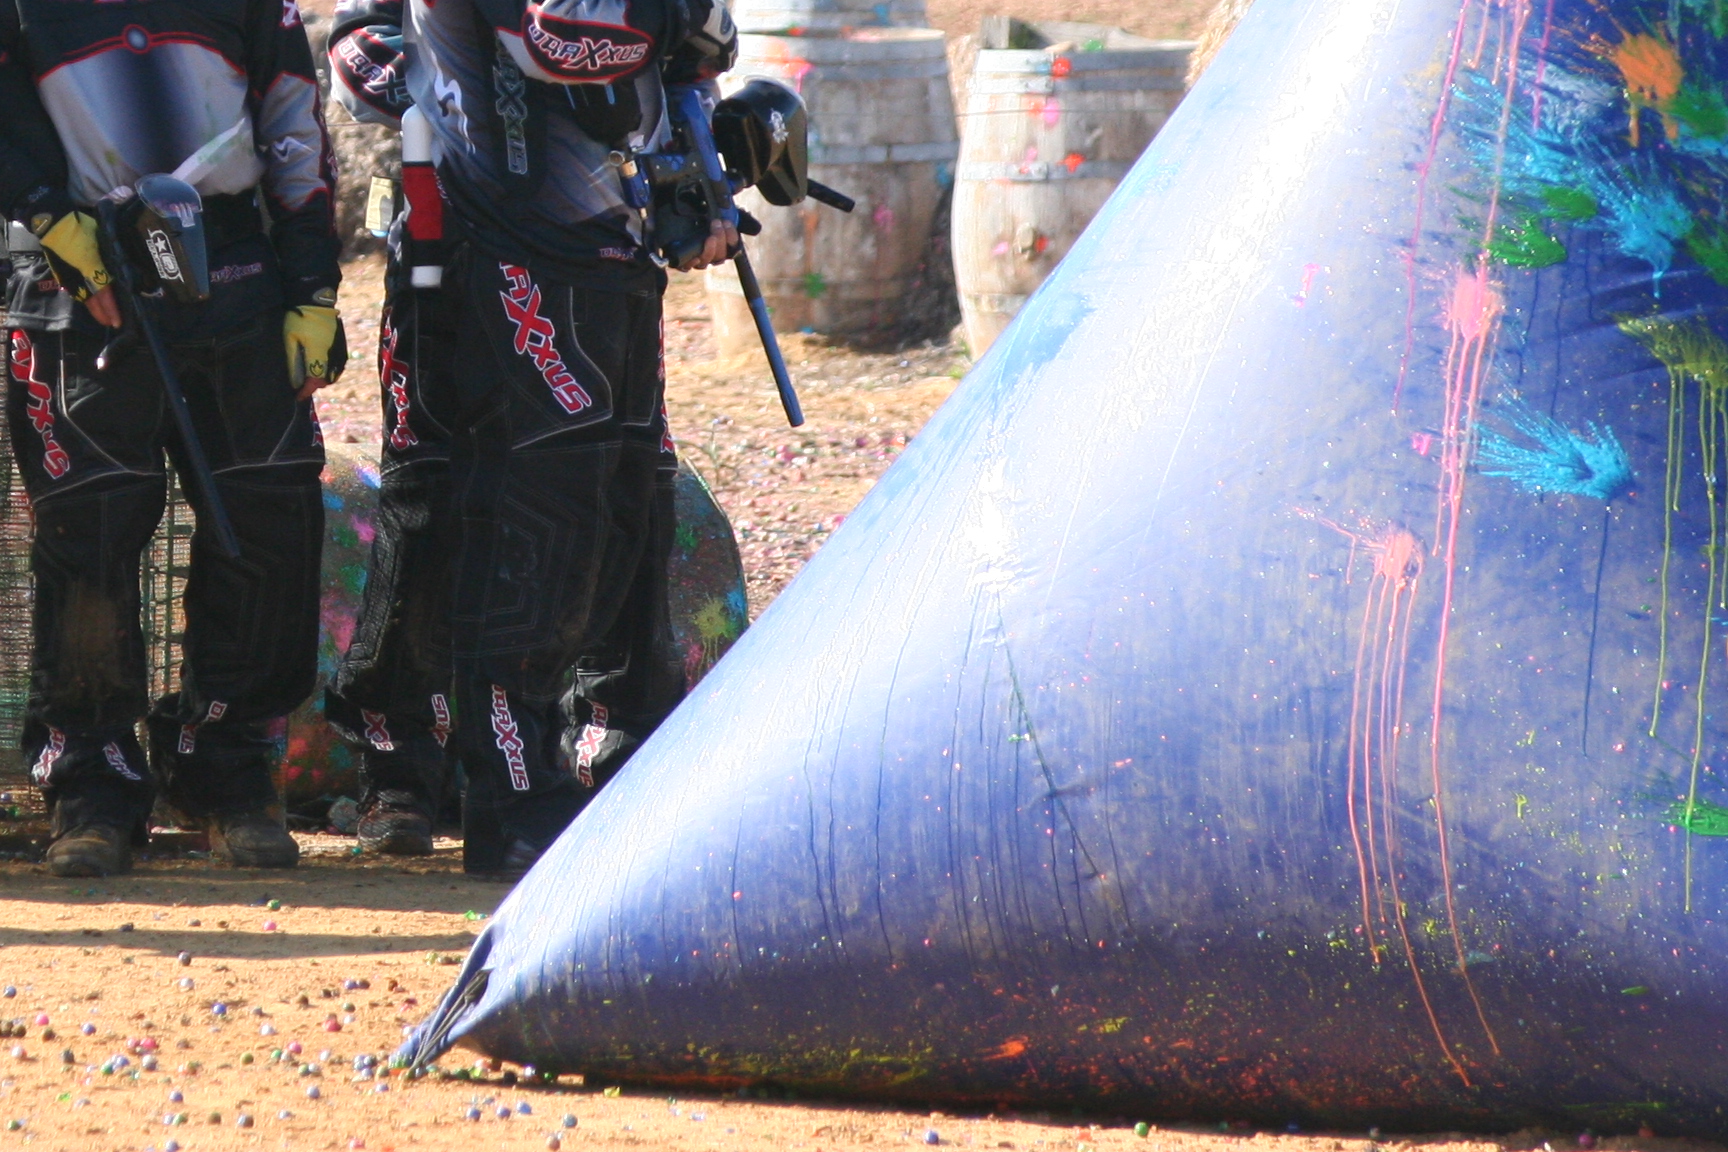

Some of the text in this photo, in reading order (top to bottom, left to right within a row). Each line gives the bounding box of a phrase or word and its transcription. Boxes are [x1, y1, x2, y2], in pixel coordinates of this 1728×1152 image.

[338, 35, 417, 106] DRAX
[528, 24, 649, 71] DRAXXUS
[498, 261, 593, 415] AXXUS
